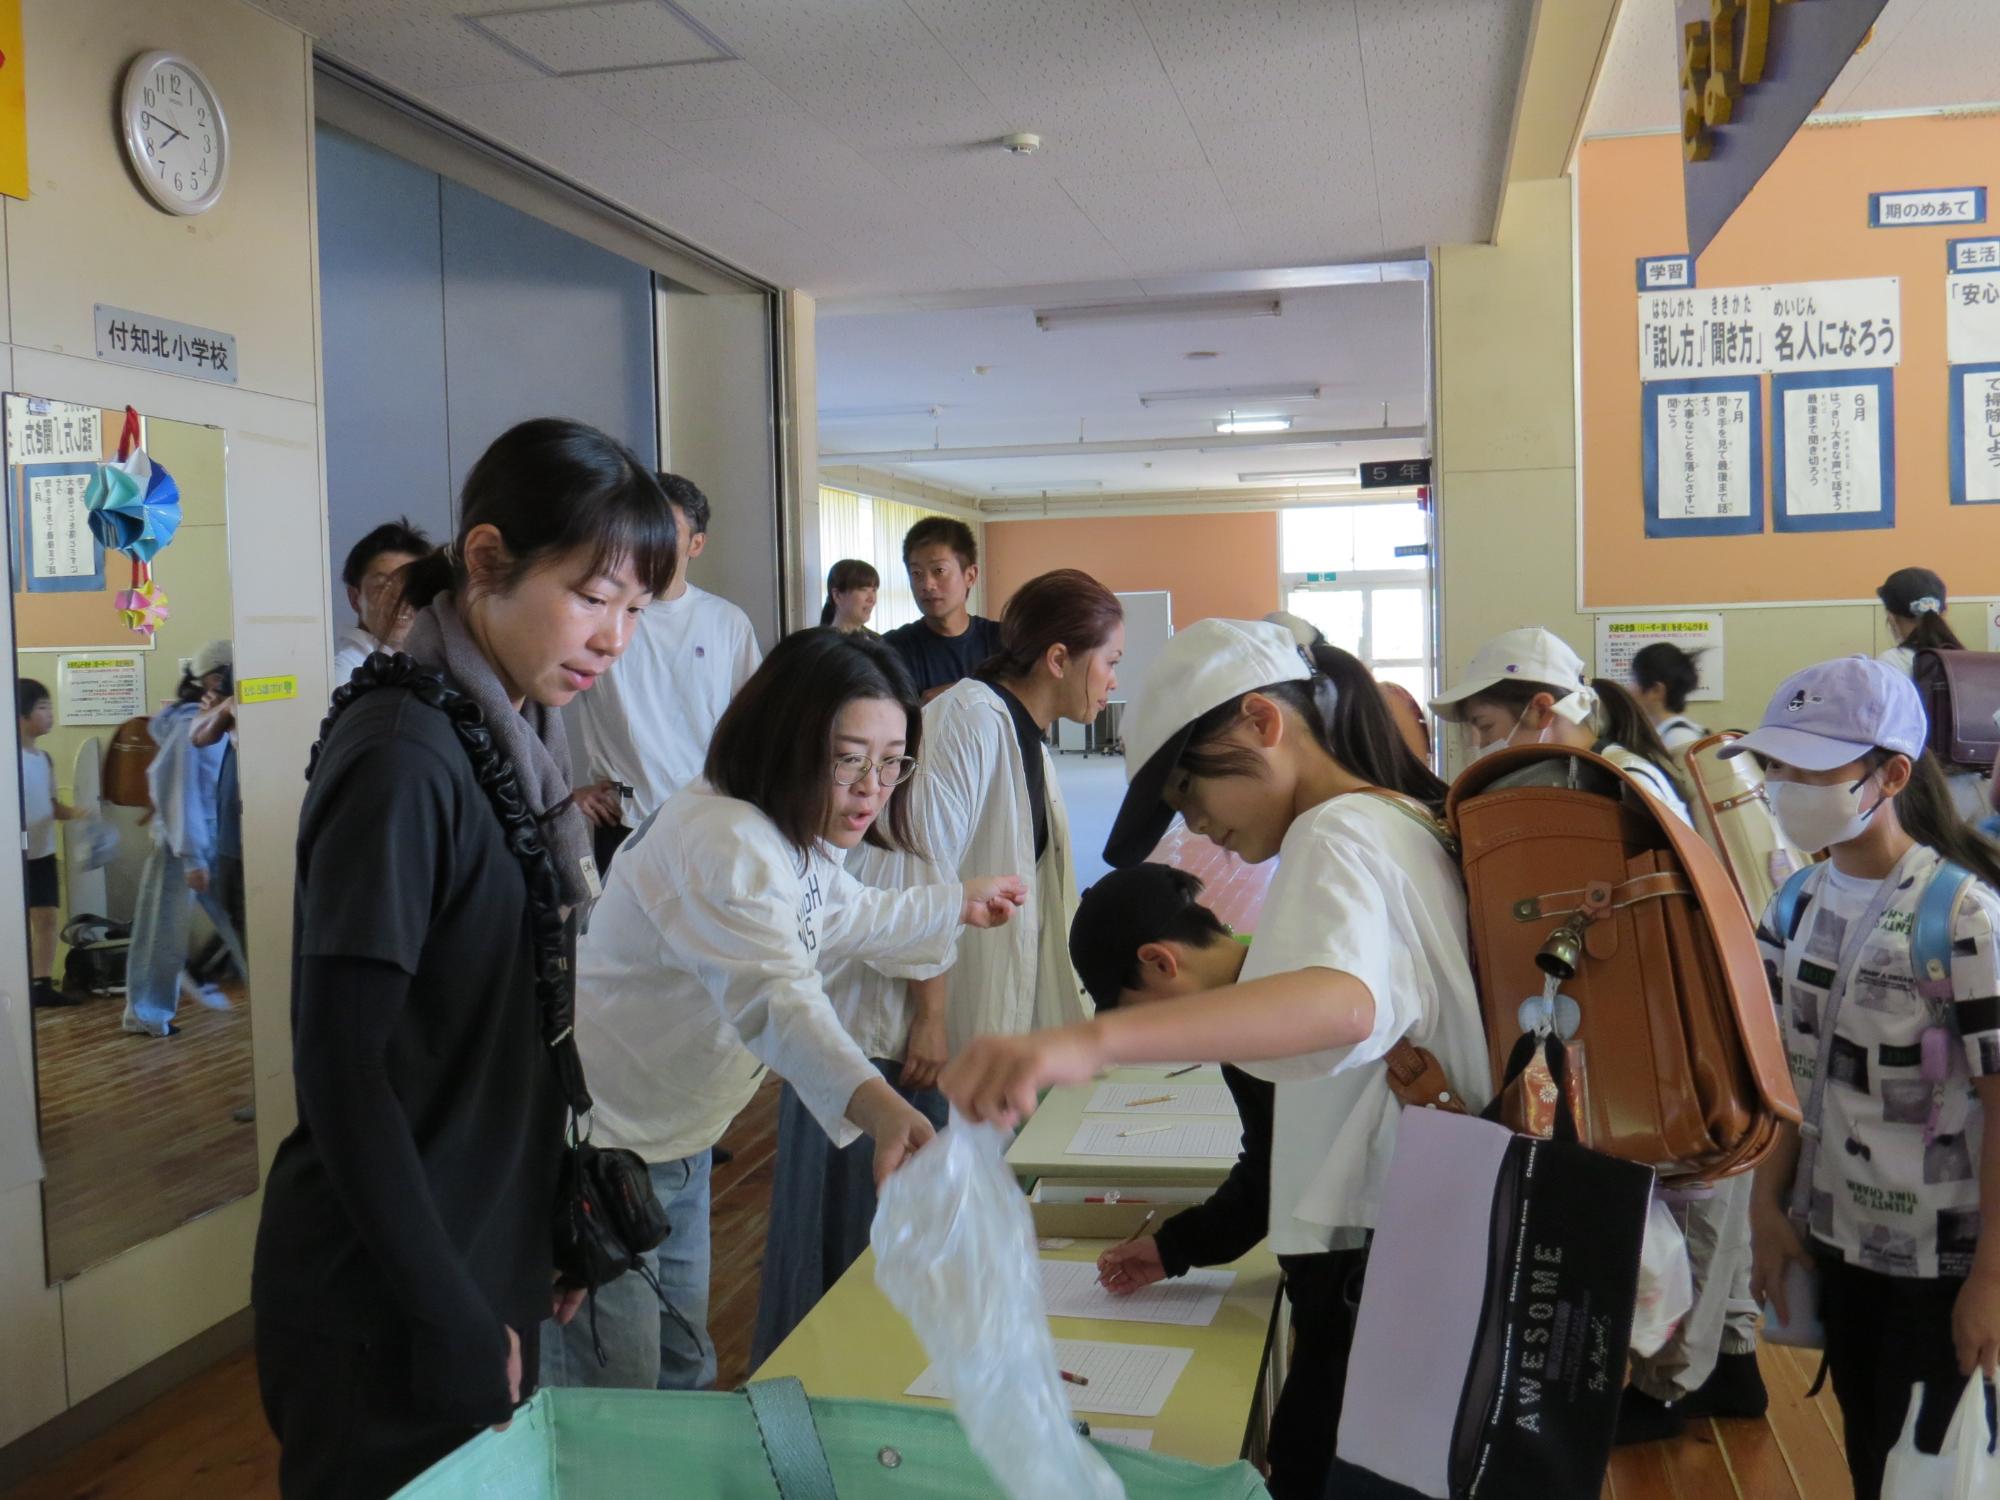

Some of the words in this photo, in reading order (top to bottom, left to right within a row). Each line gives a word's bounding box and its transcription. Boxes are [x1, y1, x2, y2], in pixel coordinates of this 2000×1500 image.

[156, 73, 165, 95] 11
[170, 73, 181, 96] 12
[144, 86, 156, 109] 10
[189, 87, 192, 107] 1
[141, 110, 150, 131] 9
[197, 107, 206, 128] 2
[146, 137, 155, 158] 8
[203, 134, 211, 154] 3
[158, 159, 166, 179] 7
[199, 157, 208, 176] 4
[174, 171, 183, 192] 6
[190, 171, 198, 191] 5
[1885, 201, 1970, 220] 期のめあて
[1960, 246, 1996, 265] 生活
[1650, 263, 1684, 281] 学習
[1773, 296, 1816, 317] めいじん
[109, 319, 229, 372] 付知北小学校
[1774, 318, 1894, 362] 名人になろう
[1515, 1243, 1563, 1434] AWESOME
